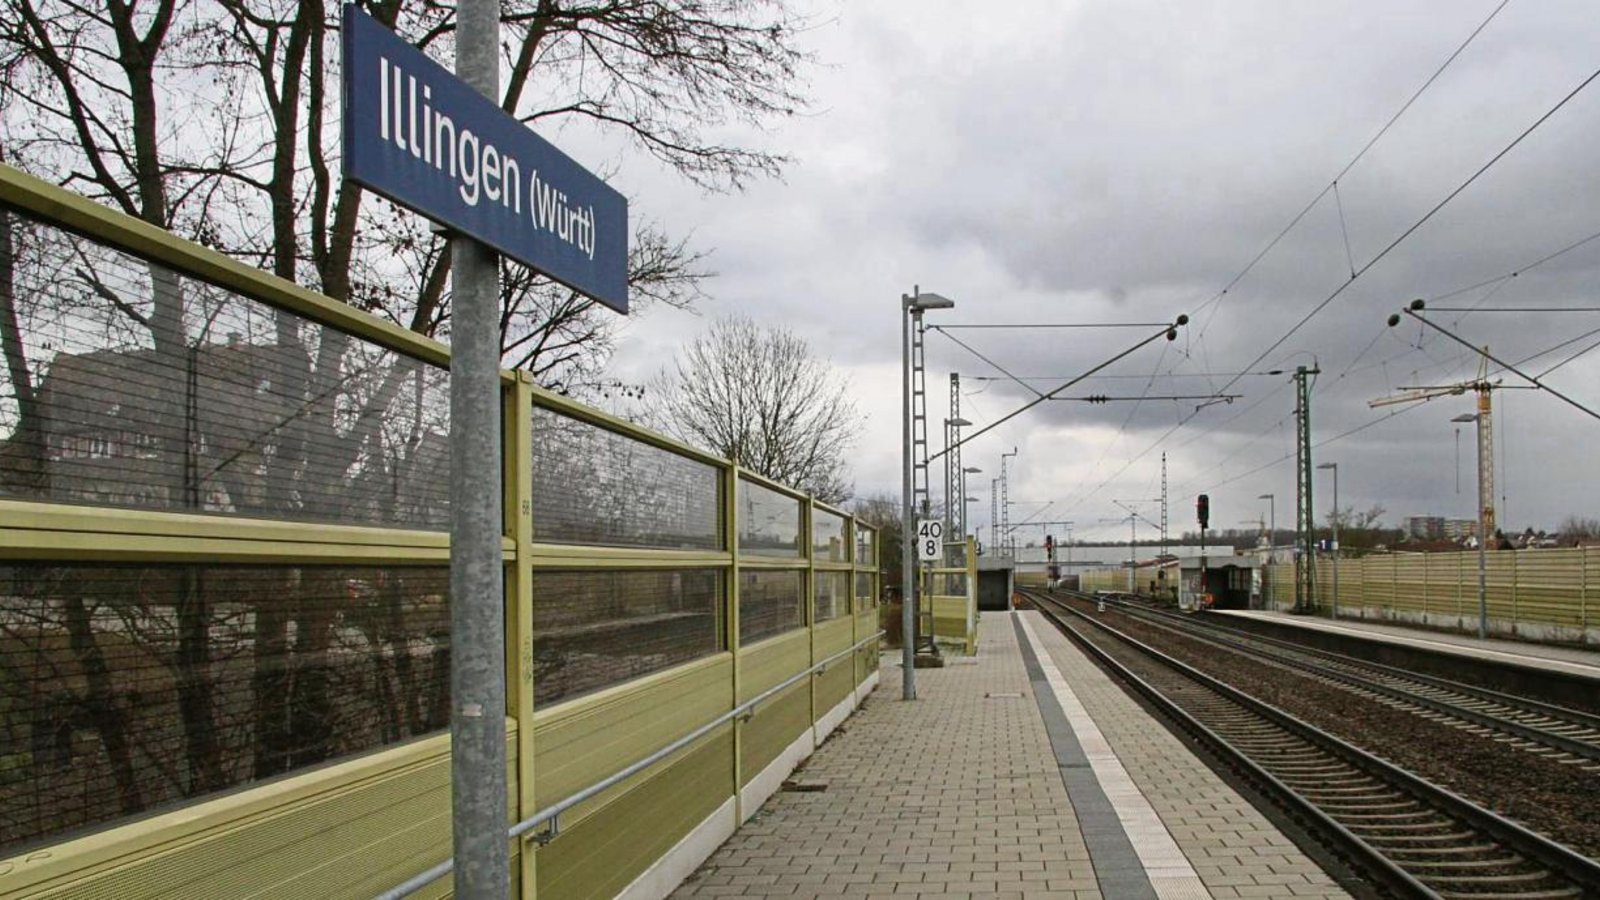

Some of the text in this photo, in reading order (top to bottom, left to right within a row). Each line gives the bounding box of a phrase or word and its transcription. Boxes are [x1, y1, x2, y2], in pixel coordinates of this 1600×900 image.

[380, 56, 596, 261] Illingen (Württ)
[919, 521, 942, 538] 40
[925, 540, 936, 556] 8
